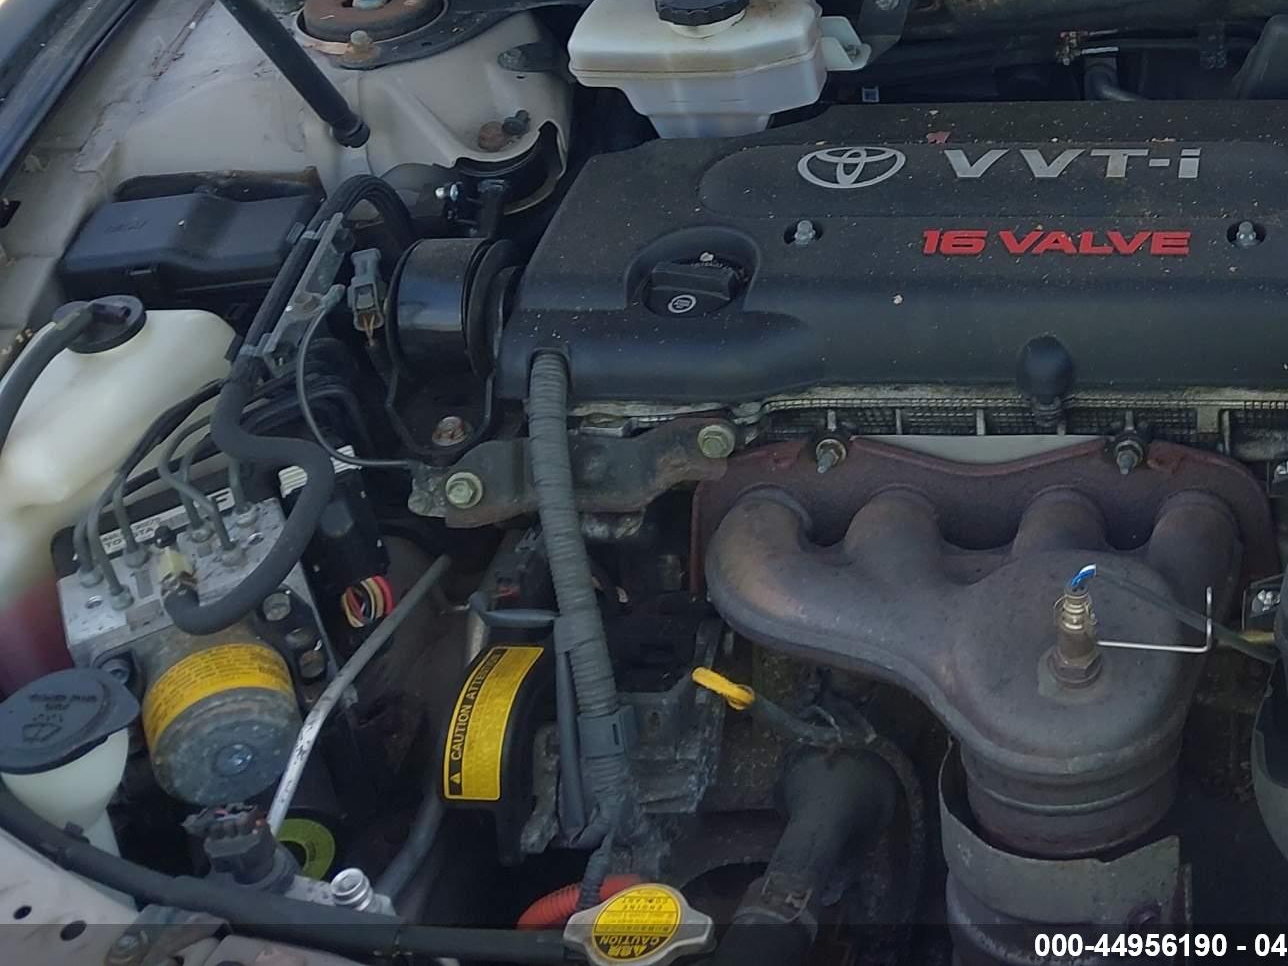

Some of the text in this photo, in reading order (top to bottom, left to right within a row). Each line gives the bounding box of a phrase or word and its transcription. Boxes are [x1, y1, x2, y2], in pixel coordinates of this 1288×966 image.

[944, 148, 1200, 178] VVT-i
[922, 229, 1192, 255] 16 VALVE
[451, 701, 472, 761] CAUTION
[599, 936, 660, 946] CAUTION
